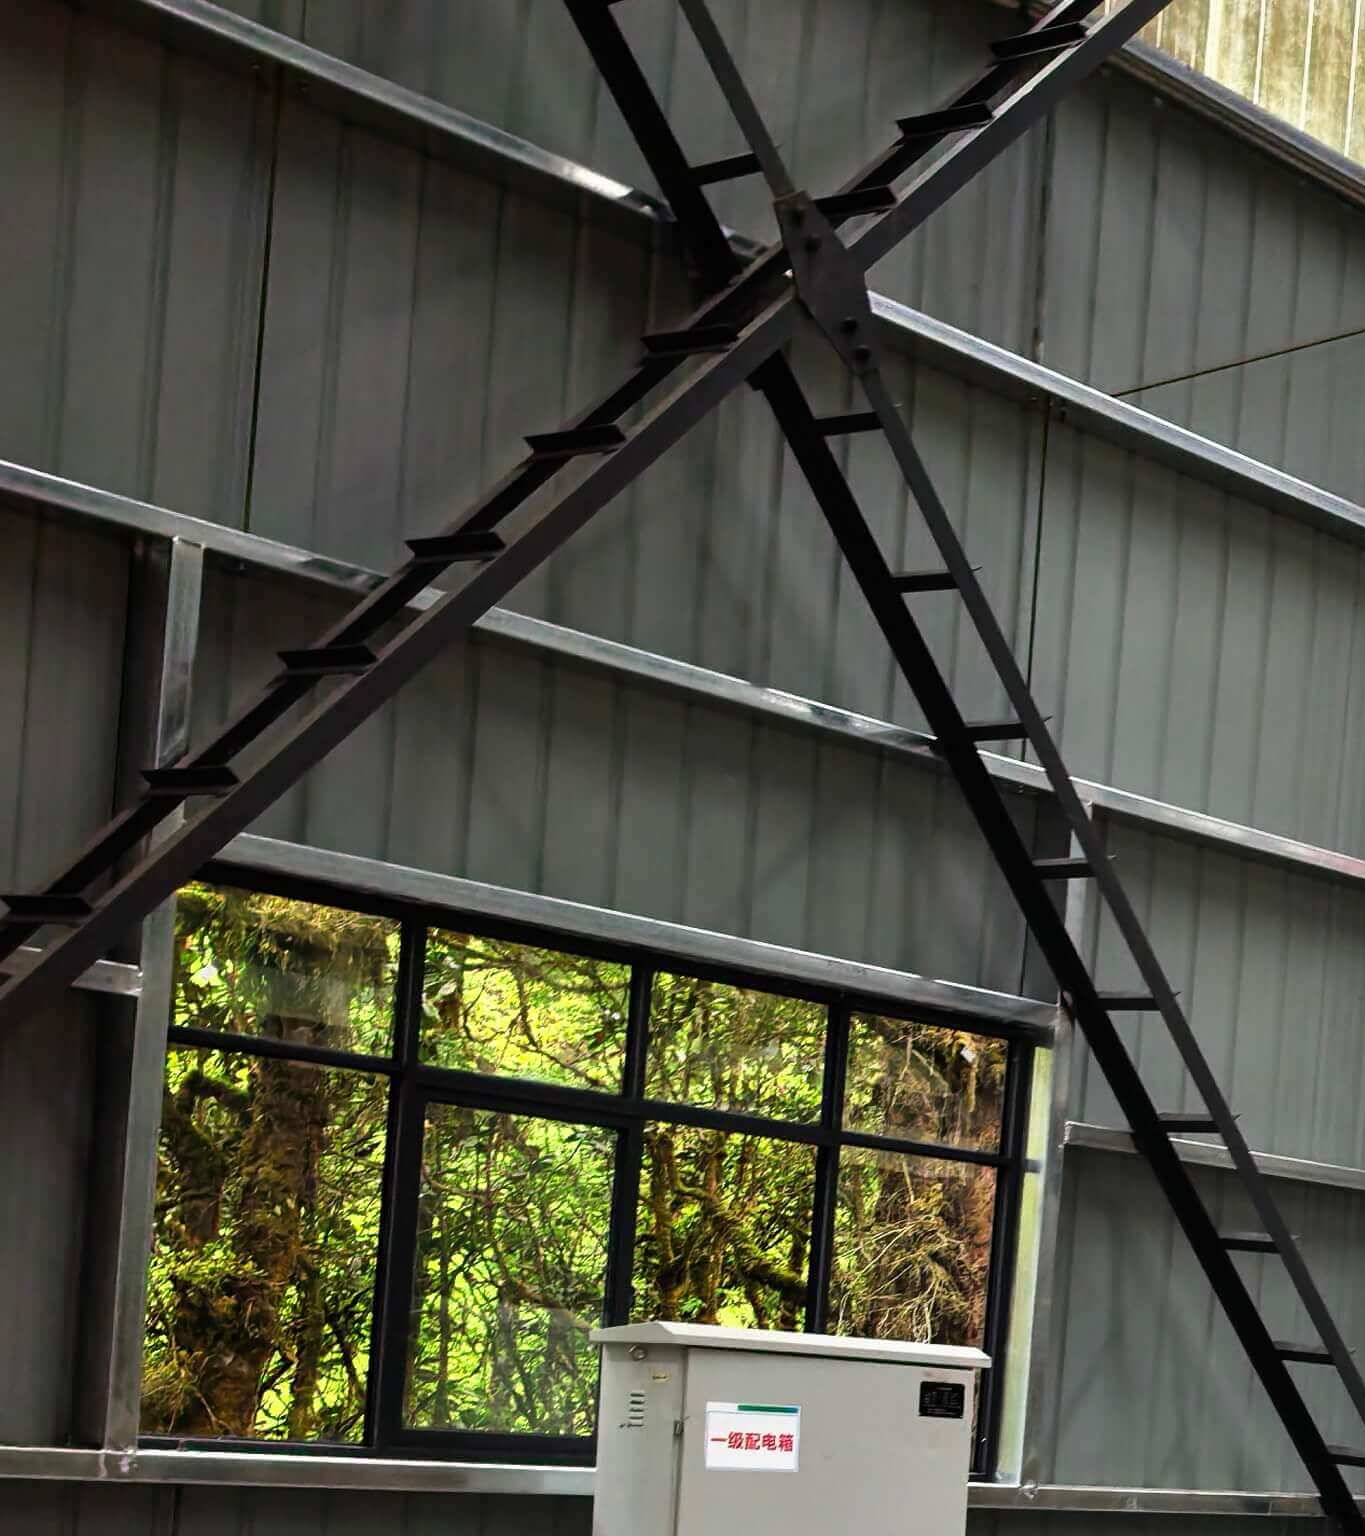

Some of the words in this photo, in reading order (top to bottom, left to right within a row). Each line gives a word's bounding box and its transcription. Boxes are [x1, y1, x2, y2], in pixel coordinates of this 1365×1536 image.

[710, 1431, 794, 1452] 一级配电箱
